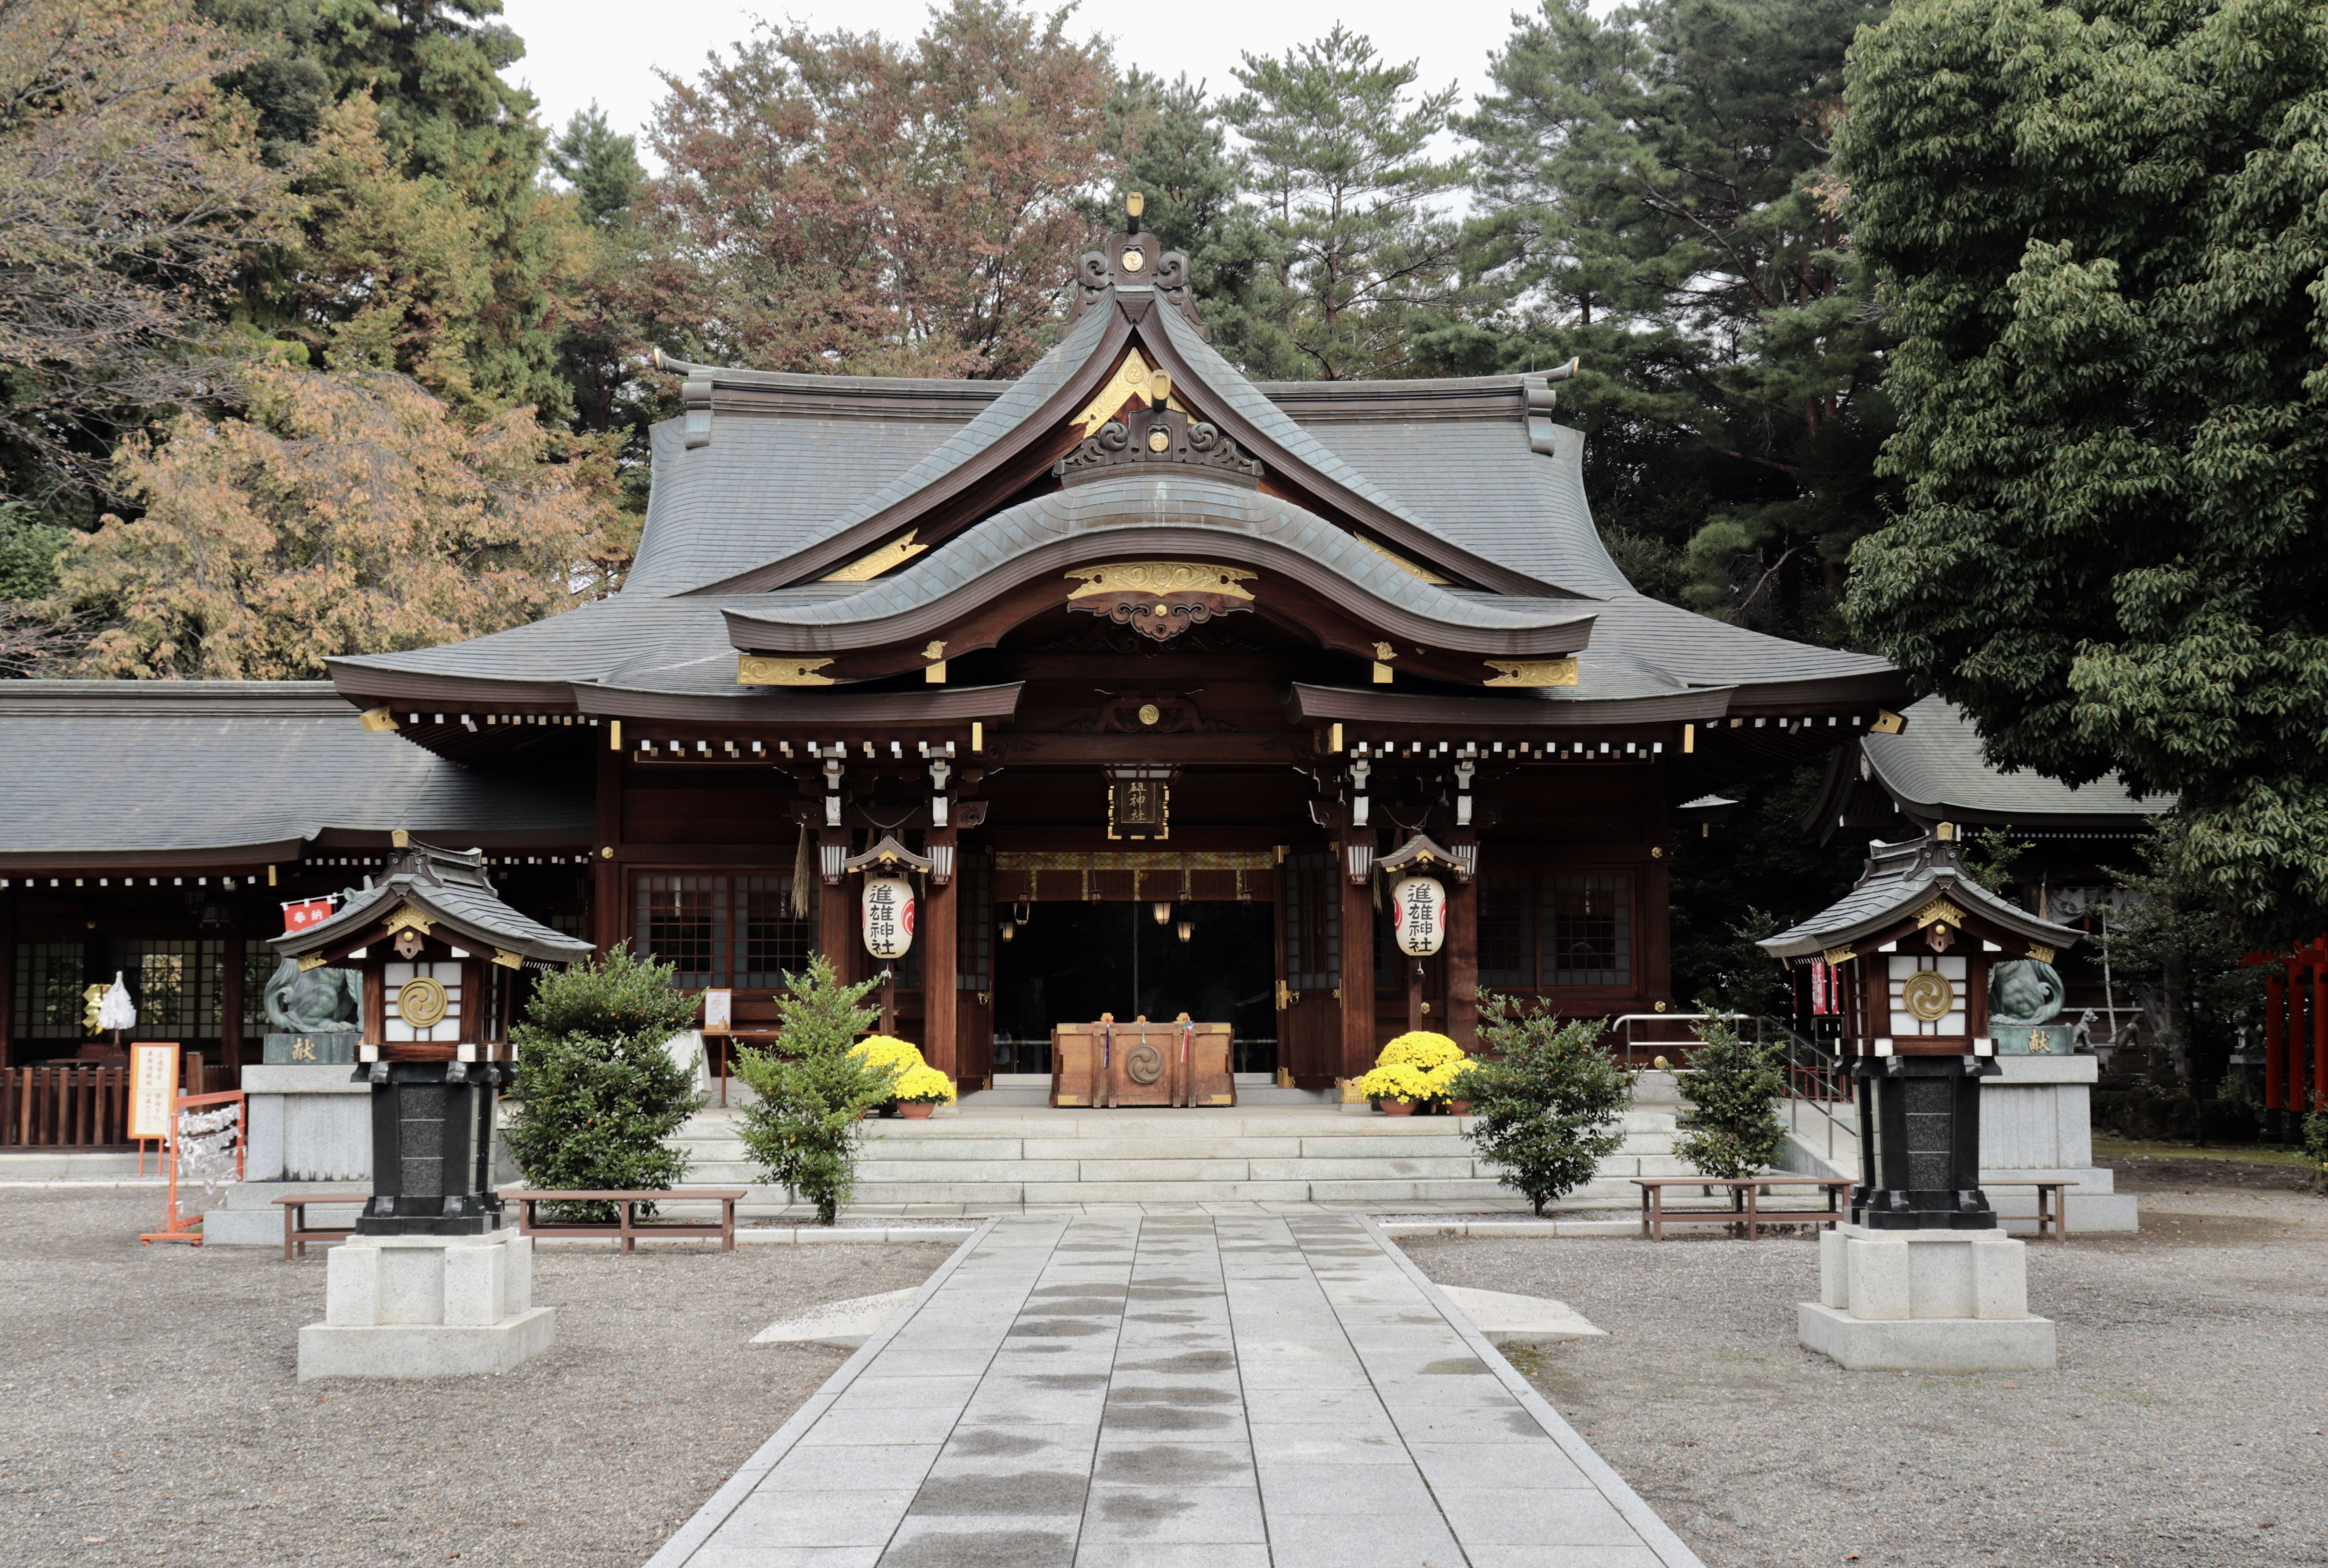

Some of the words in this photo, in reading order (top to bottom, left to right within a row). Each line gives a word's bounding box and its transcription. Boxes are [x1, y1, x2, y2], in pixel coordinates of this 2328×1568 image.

[294, 909, 323, 923] 奉納
[869, 884, 897, 955] 進雄神社
[1407, 884, 1434, 952] 進雄神社
